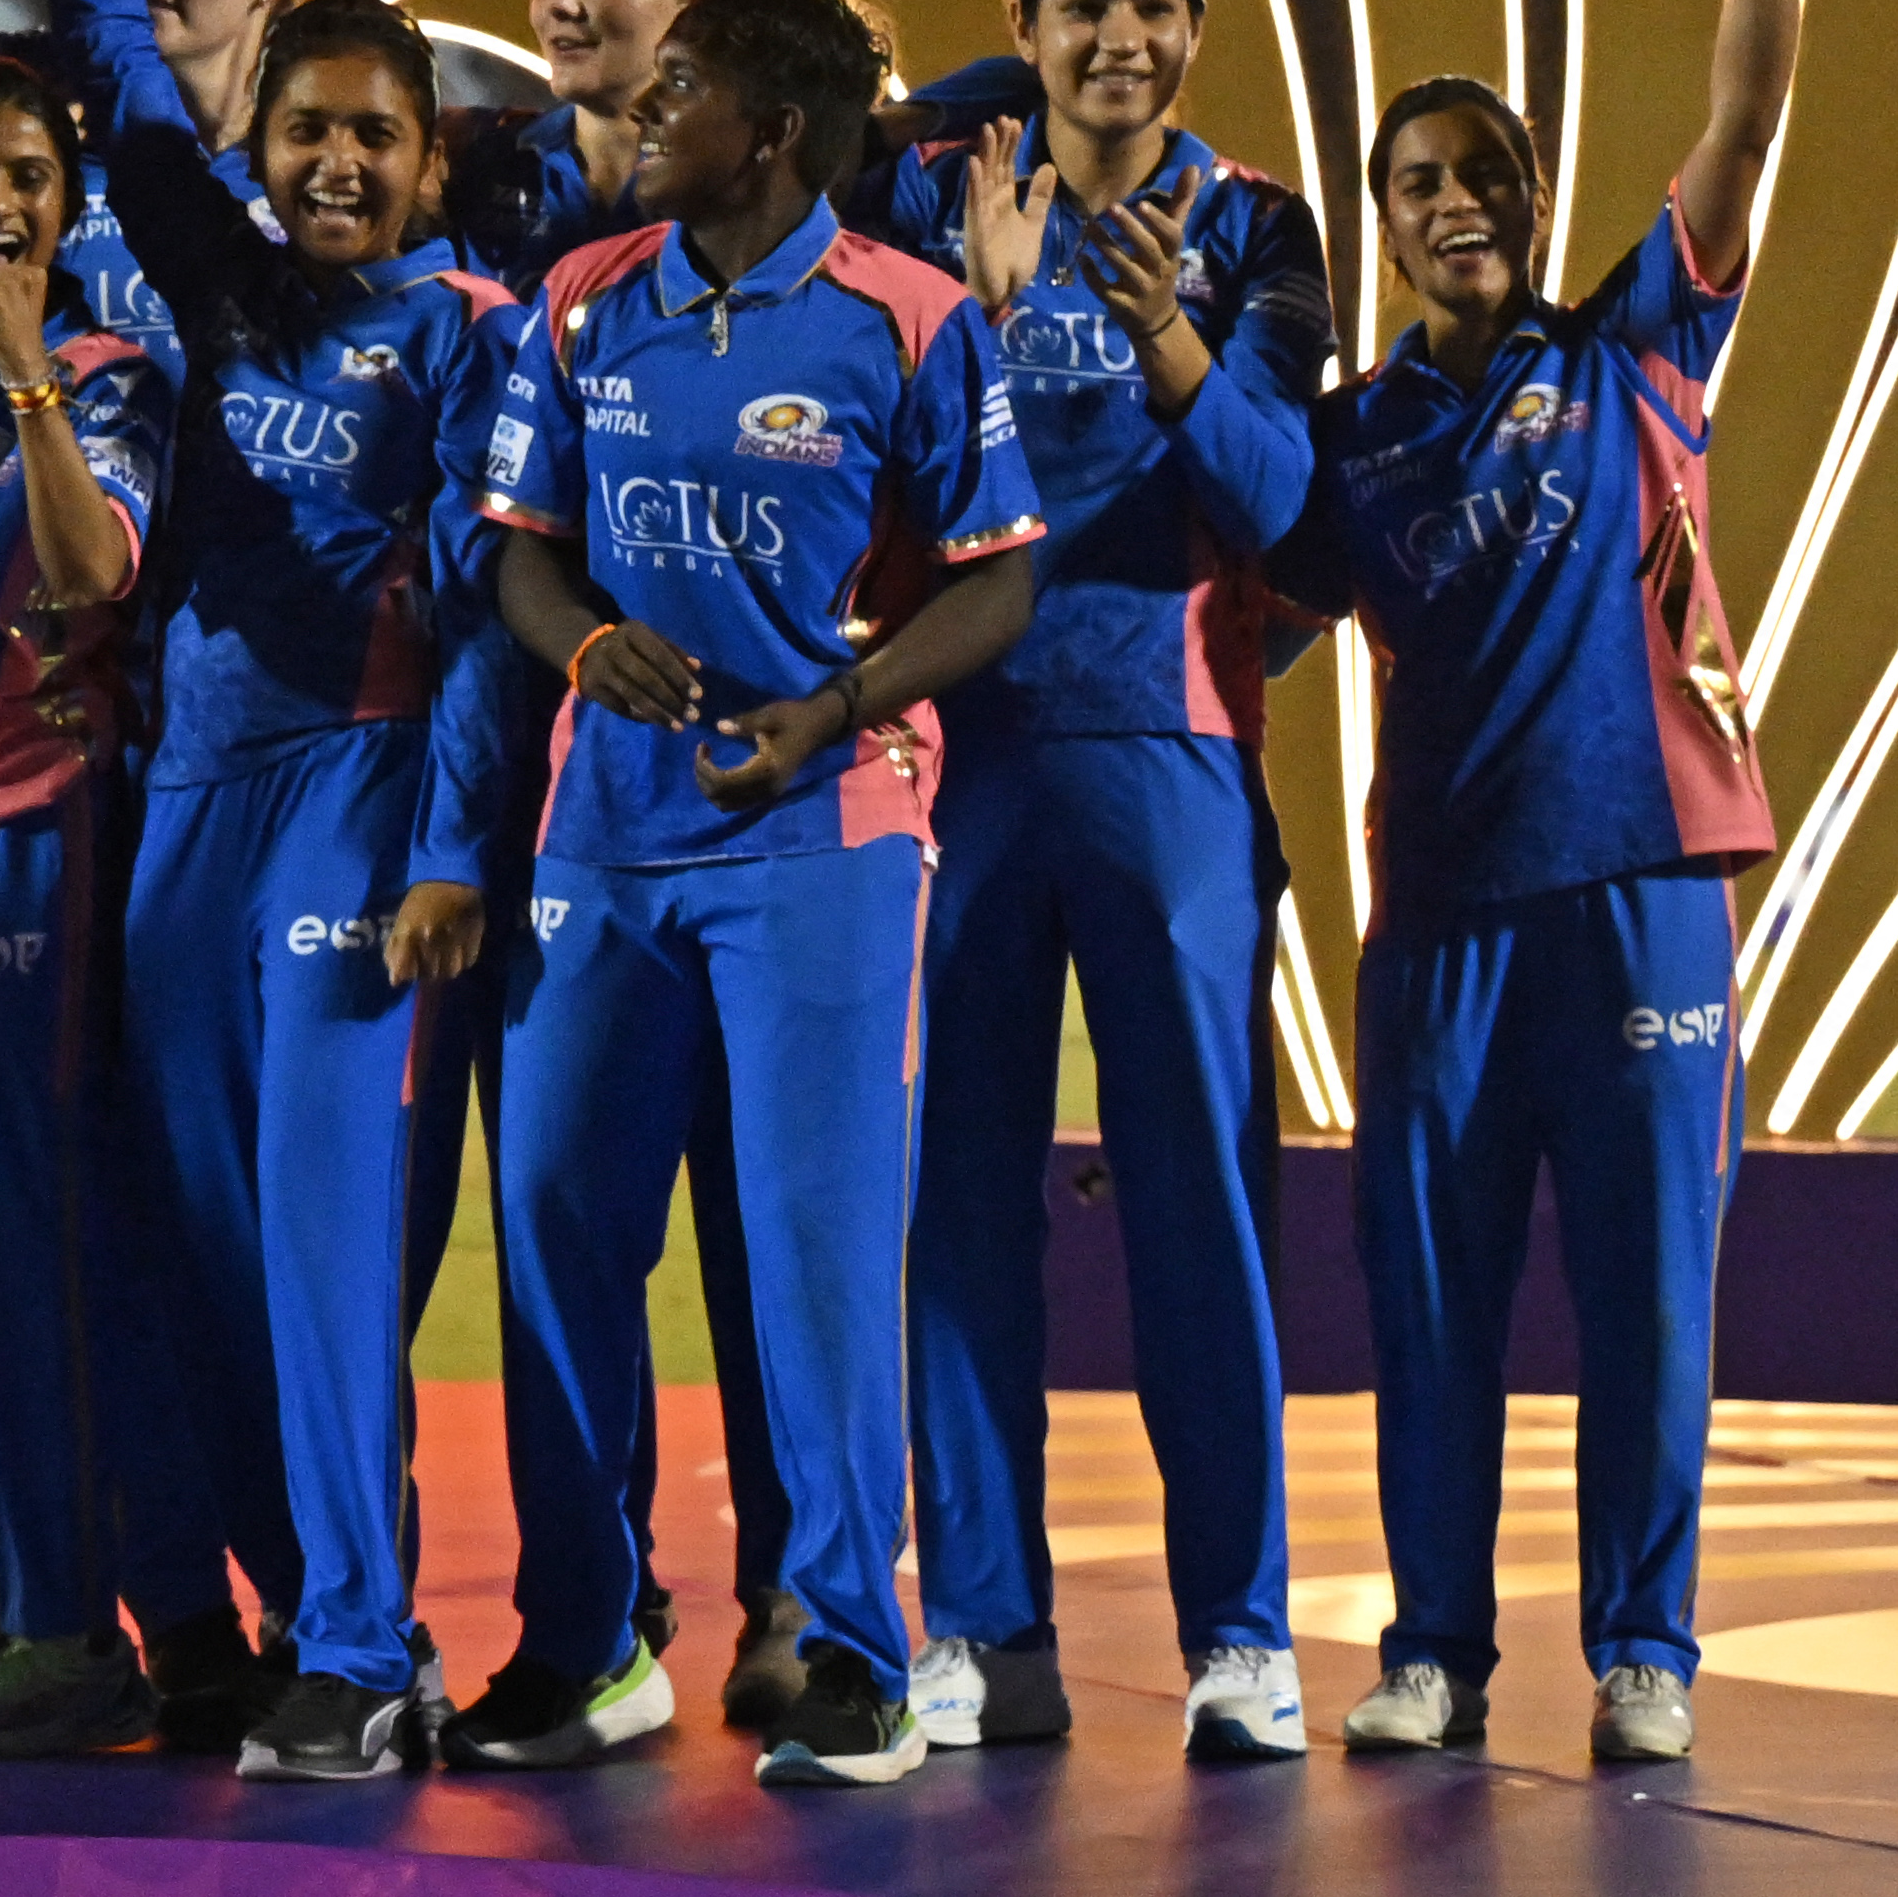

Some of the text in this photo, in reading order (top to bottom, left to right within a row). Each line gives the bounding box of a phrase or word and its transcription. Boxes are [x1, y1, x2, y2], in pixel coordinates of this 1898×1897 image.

[205, 390, 363, 466] OTUS
[599, 470, 785, 558] LOTUS
[1385, 468, 1575, 584] LOTUS
